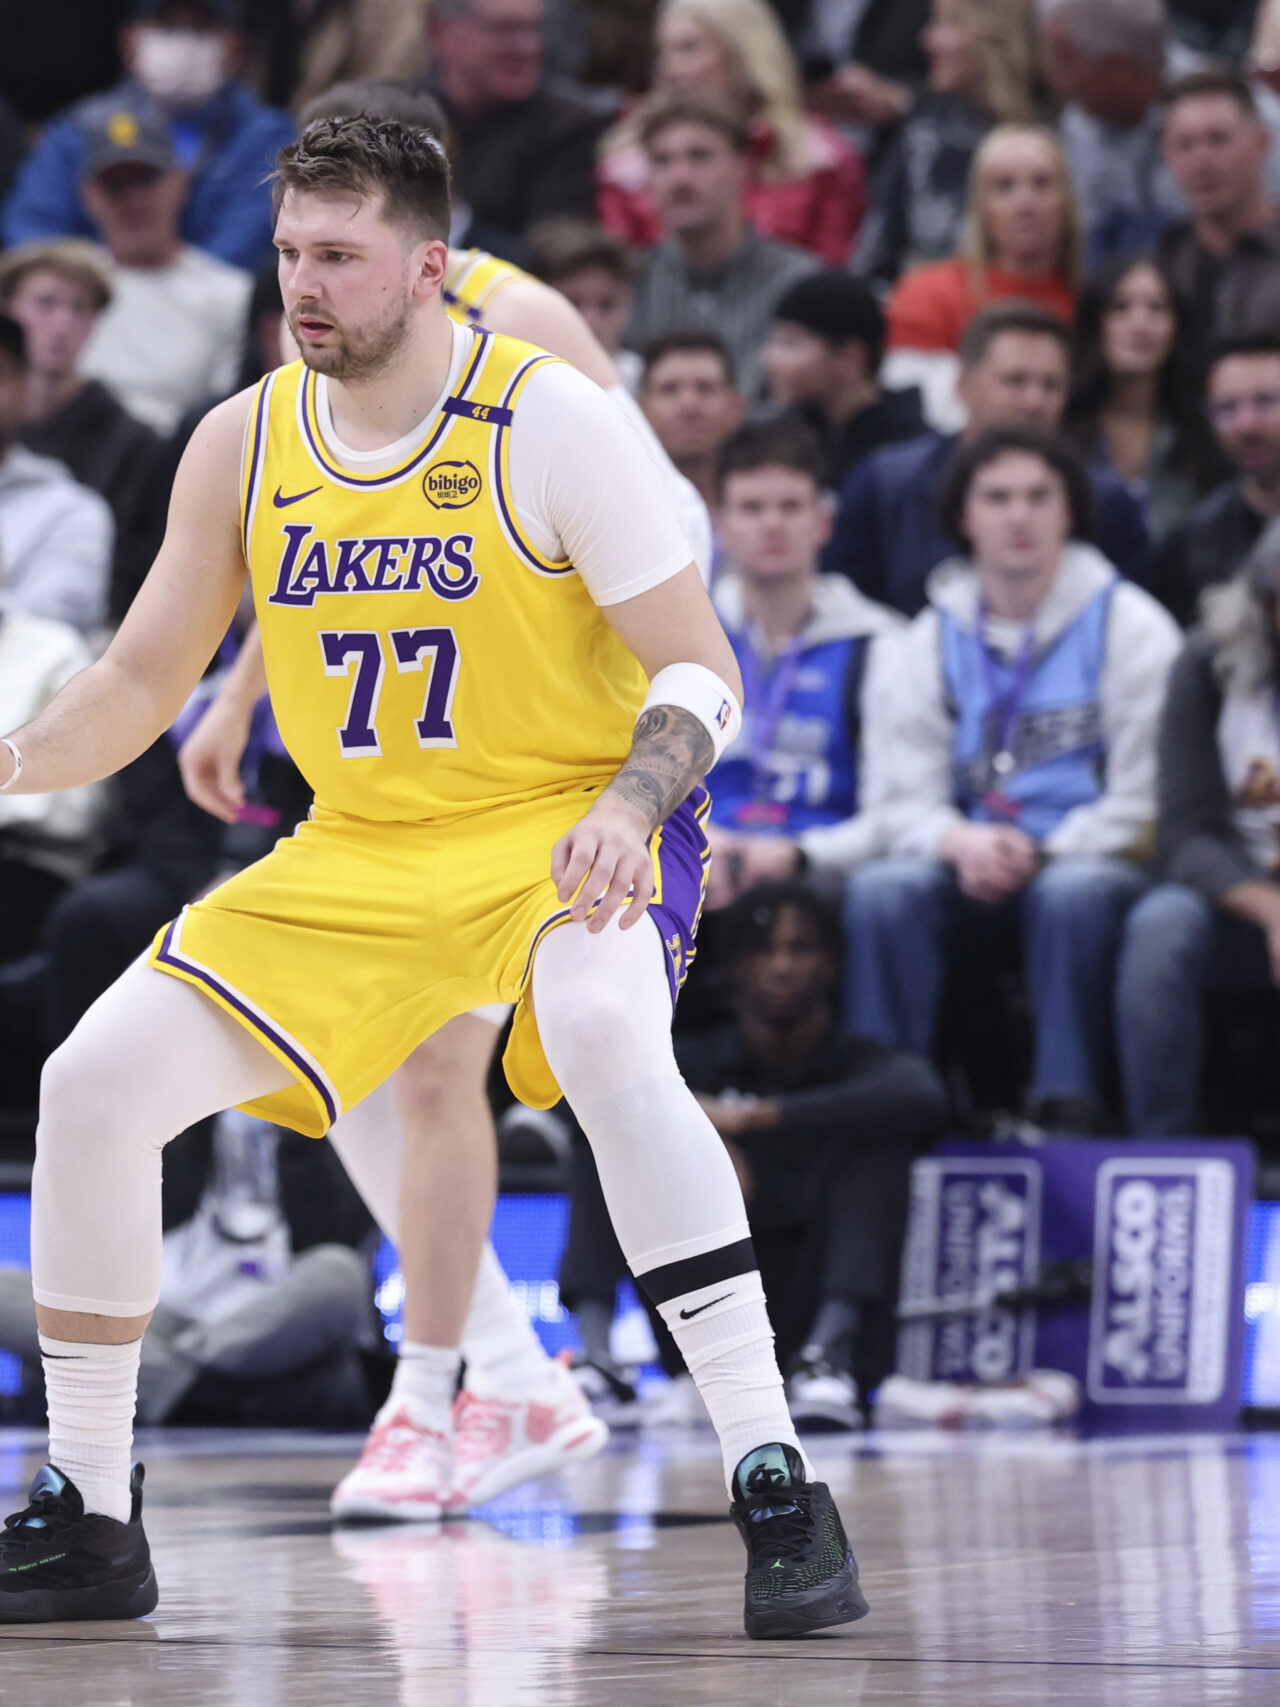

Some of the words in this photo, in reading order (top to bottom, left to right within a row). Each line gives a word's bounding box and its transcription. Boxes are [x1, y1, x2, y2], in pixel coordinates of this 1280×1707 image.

[472, 406, 490, 419] 44
[428, 473, 478, 494] bibigo
[266, 522, 481, 608] LAKERS
[317, 625, 462, 759] 77
[1103, 1181, 1157, 1381] ALSCO
